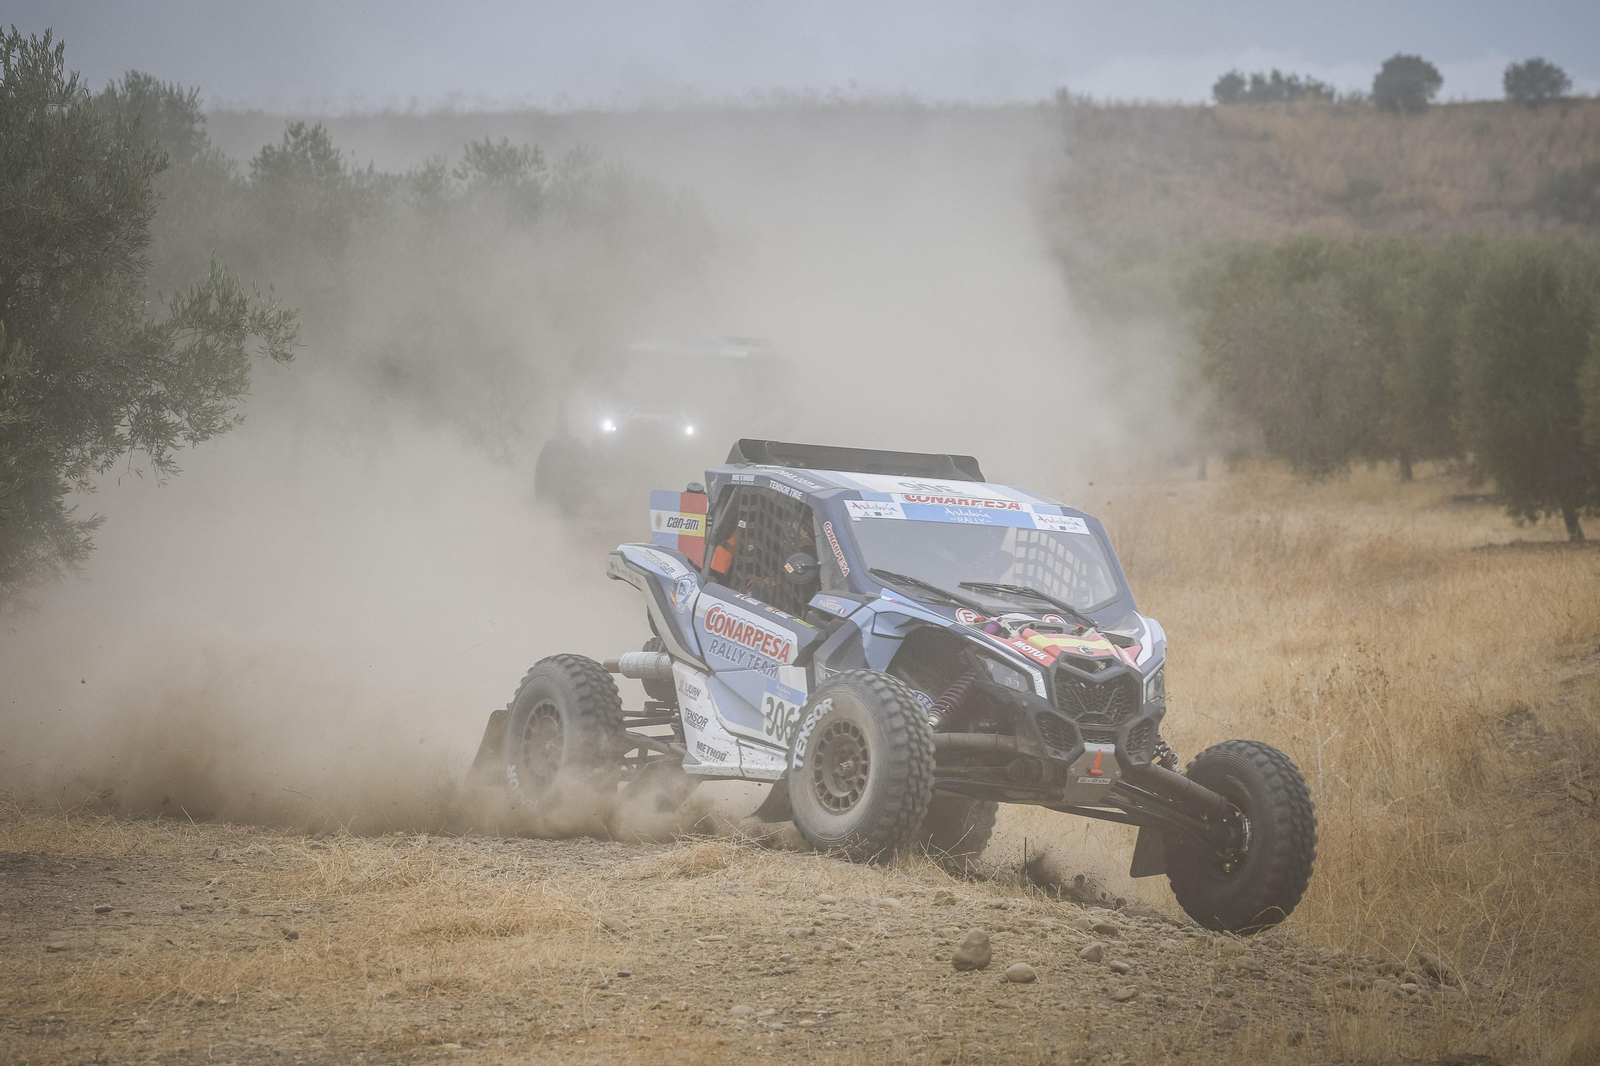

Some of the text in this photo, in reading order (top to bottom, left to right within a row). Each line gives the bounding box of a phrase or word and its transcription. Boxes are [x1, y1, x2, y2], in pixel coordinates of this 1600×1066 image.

[769, 480, 790, 495] TENSOR
[788, 487, 803, 500] TIRE
[666, 516, 700, 531] can-am
[956, 516, 986, 525] RALLY
[823, 521, 850, 577] CONARPESA
[704, 605, 791, 664] CONARPESA
[708, 638, 779, 680] RALLY TEAM
[1011, 640, 1049, 661] MOTUL
[685, 707, 709, 728] TENSOR
[765, 696, 796, 747] 306
[792, 697, 834, 770] TENSOR
